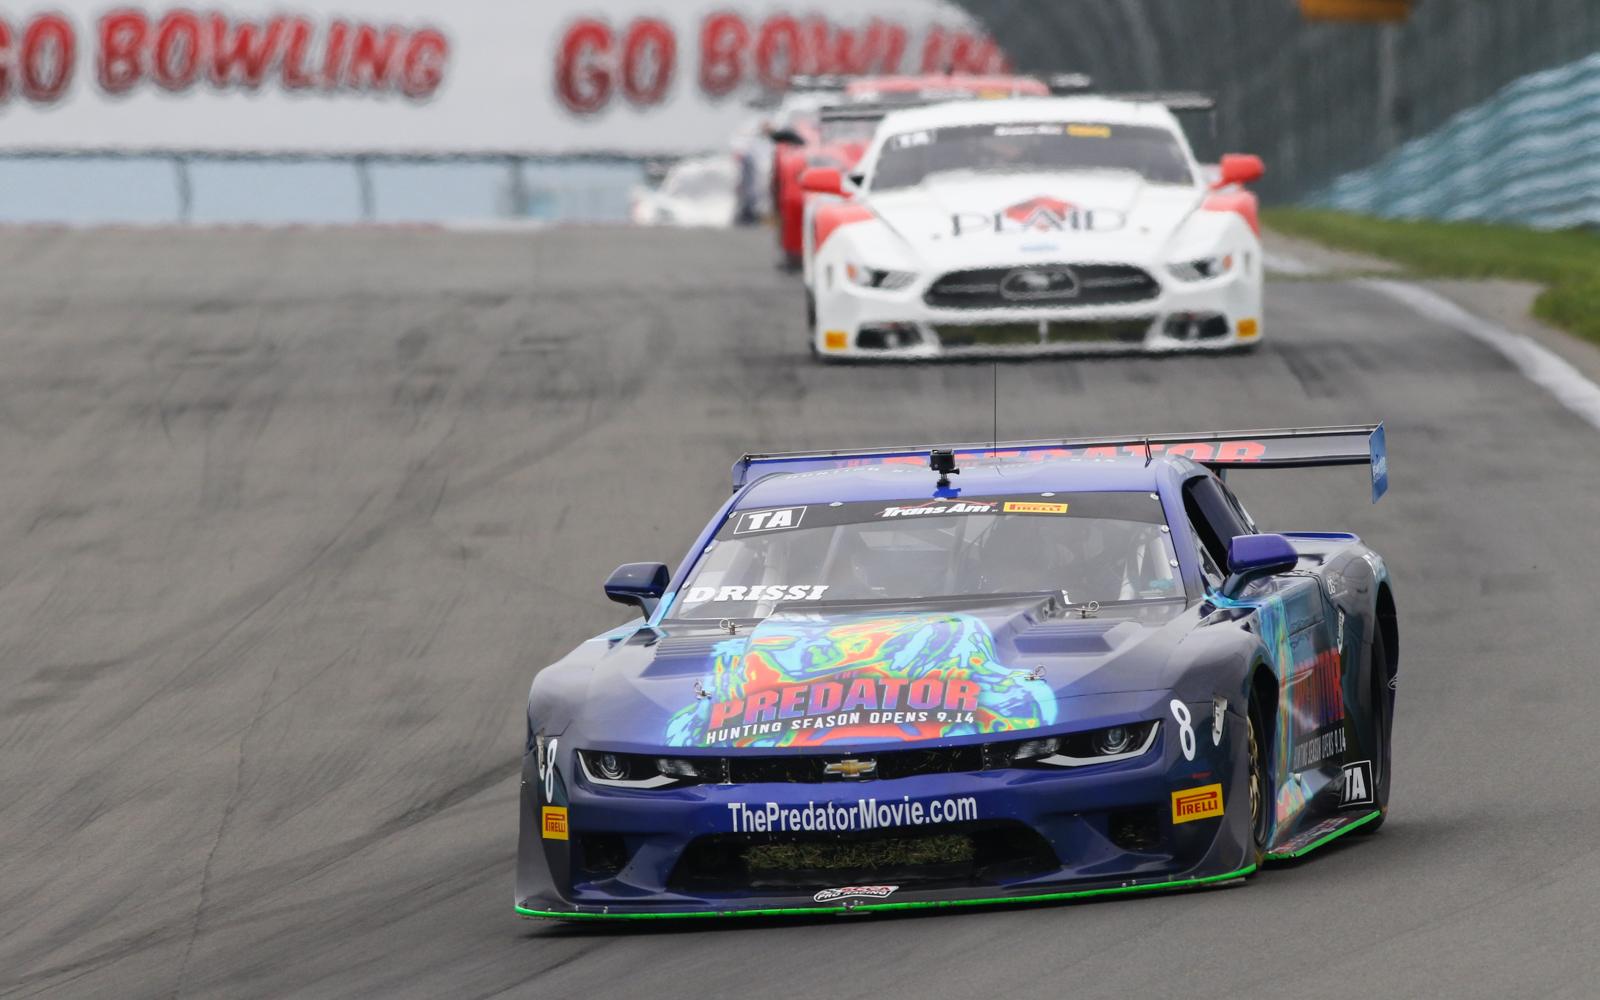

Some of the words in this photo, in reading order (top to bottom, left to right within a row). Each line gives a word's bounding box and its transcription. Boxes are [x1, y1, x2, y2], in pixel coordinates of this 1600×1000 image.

[0, 13, 76, 101] O
[97, 9, 448, 97] BOWLING
[555, 15, 676, 113] GO
[700, 11, 1012, 94] BOWLIN
[951, 205, 1128, 236] PLAID
[748, 510, 793, 530] TA
[882, 506, 945, 518] Trans
[945, 502, 991, 513] Am
[683, 585, 829, 603] DRISSI
[709, 678, 981, 729] PREDATOR
[706, 721, 782, 745] HUNTING
[791, 712, 861, 730] SEASON
[869, 711, 929, 725] OPENS
[936, 711, 976, 724] 9.14
[1169, 699, 1196, 762] 8
[545, 738, 558, 803] 8
[1344, 766, 1367, 802] TA
[728, 795, 978, 832] ThePredatorMovie.com
[1176, 791, 1218, 817] PIRELLI
[545, 813, 567, 833] PIRELLI
